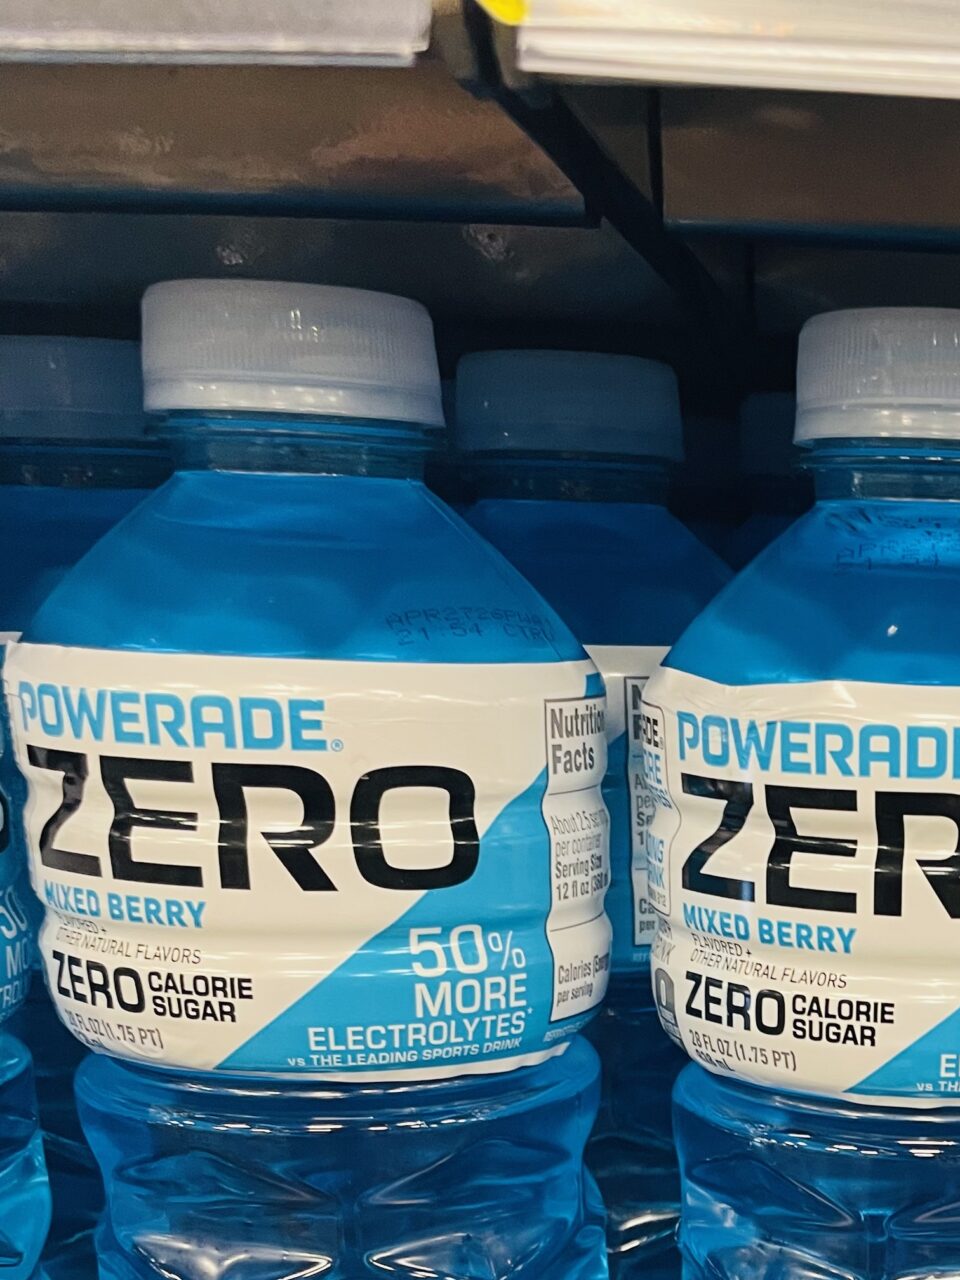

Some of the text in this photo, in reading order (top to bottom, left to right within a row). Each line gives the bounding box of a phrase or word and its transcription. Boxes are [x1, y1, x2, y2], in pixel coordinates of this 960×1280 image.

[18, 681, 327, 751] POWERADE
[552, 745, 596, 776] Facts
[27, 746, 480, 891] ZERO
[44, 880, 206, 928] MIXED BERRY
[683, 902, 750, 941] MIXED
[758, 918, 857, 954] BERRY
[692, 933, 742, 956] FLAVORED
[82, 934, 201, 965] NATURAL FLAVORS
[409, 924, 527, 978] 50%
[690, 948, 848, 989] OTHER NATURAL FLAVORS
[52, 950, 145, 1013] ZERO
[149, 971, 253, 1000] CALORIE
[414, 973, 527, 1018] MORE
[153, 995, 237, 1023] SUGAR
[685, 970, 786, 1036] ZERO
[792, 994, 895, 1024] CALORIE
[310, 1037, 523, 1067] THE LEADING SPORTS DRINK
[703, 1033, 798, 1072] FL OZ PT)
[792, 1018, 876, 1047] SUGAR
